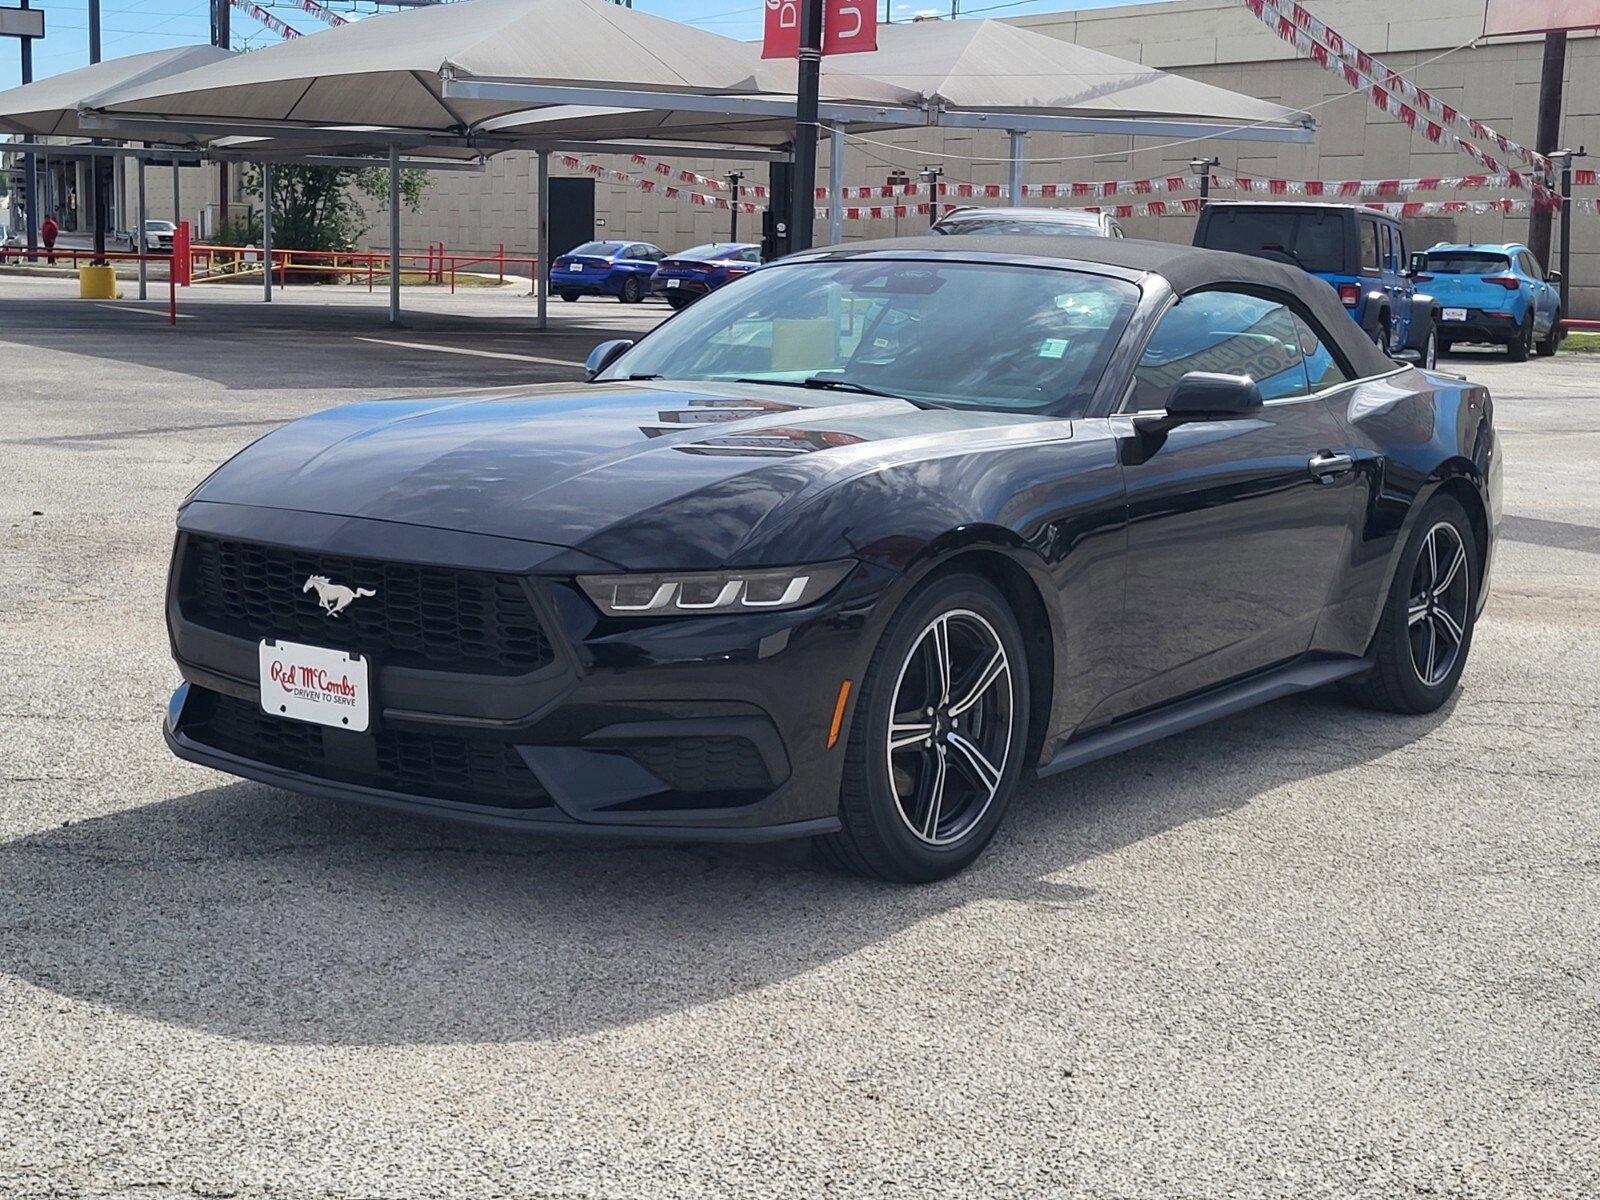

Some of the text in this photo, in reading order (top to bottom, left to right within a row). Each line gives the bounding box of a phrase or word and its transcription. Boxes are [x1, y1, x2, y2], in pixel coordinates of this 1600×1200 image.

[779, 0, 797, 28] D
[838, 0, 862, 38] U
[270, 660, 355, 697] Red McCombs
[293, 687, 356, 707] DRIVEN TO SERVE
